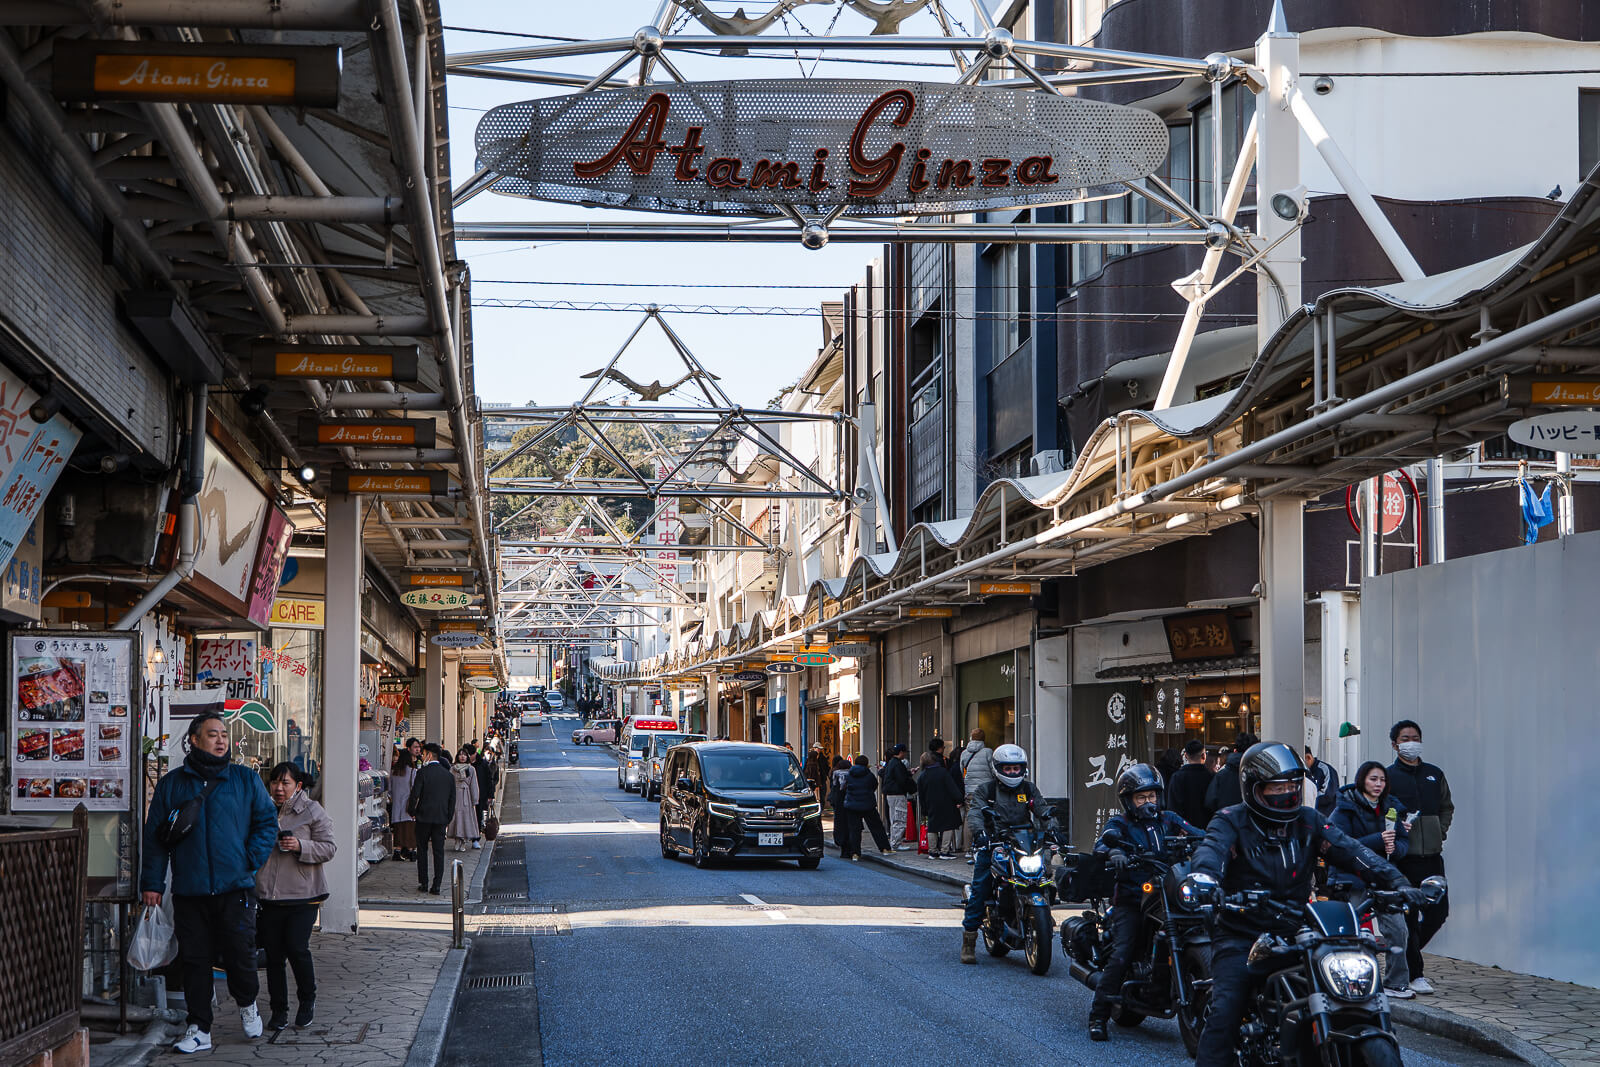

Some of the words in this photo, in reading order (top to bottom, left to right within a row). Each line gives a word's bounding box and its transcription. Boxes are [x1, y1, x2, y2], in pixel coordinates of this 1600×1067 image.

[119, 59, 200, 86] Atami
[206, 62, 269, 88] Ginza
[573, 92, 829, 193] Atami
[847, 89, 1059, 198] Ginza
[290, 356, 339, 373] Atami
[341, 357, 379, 374] Ginza
[1545, 385, 1590, 400] Atami
[330, 427, 370, 441] Atami
[372, 427, 403, 441] Ginza
[358, 478, 393, 490] Atami
[394, 478, 421, 490] Ginza
[1373, 491, 1402, 516] 火栓
[405, 593, 429, 606] 佐藤
[446, 593, 468, 605] 油店
[278, 604, 315, 621] CARE
[211, 640, 247, 657] ナイト
[200, 654, 252, 671] スポット
